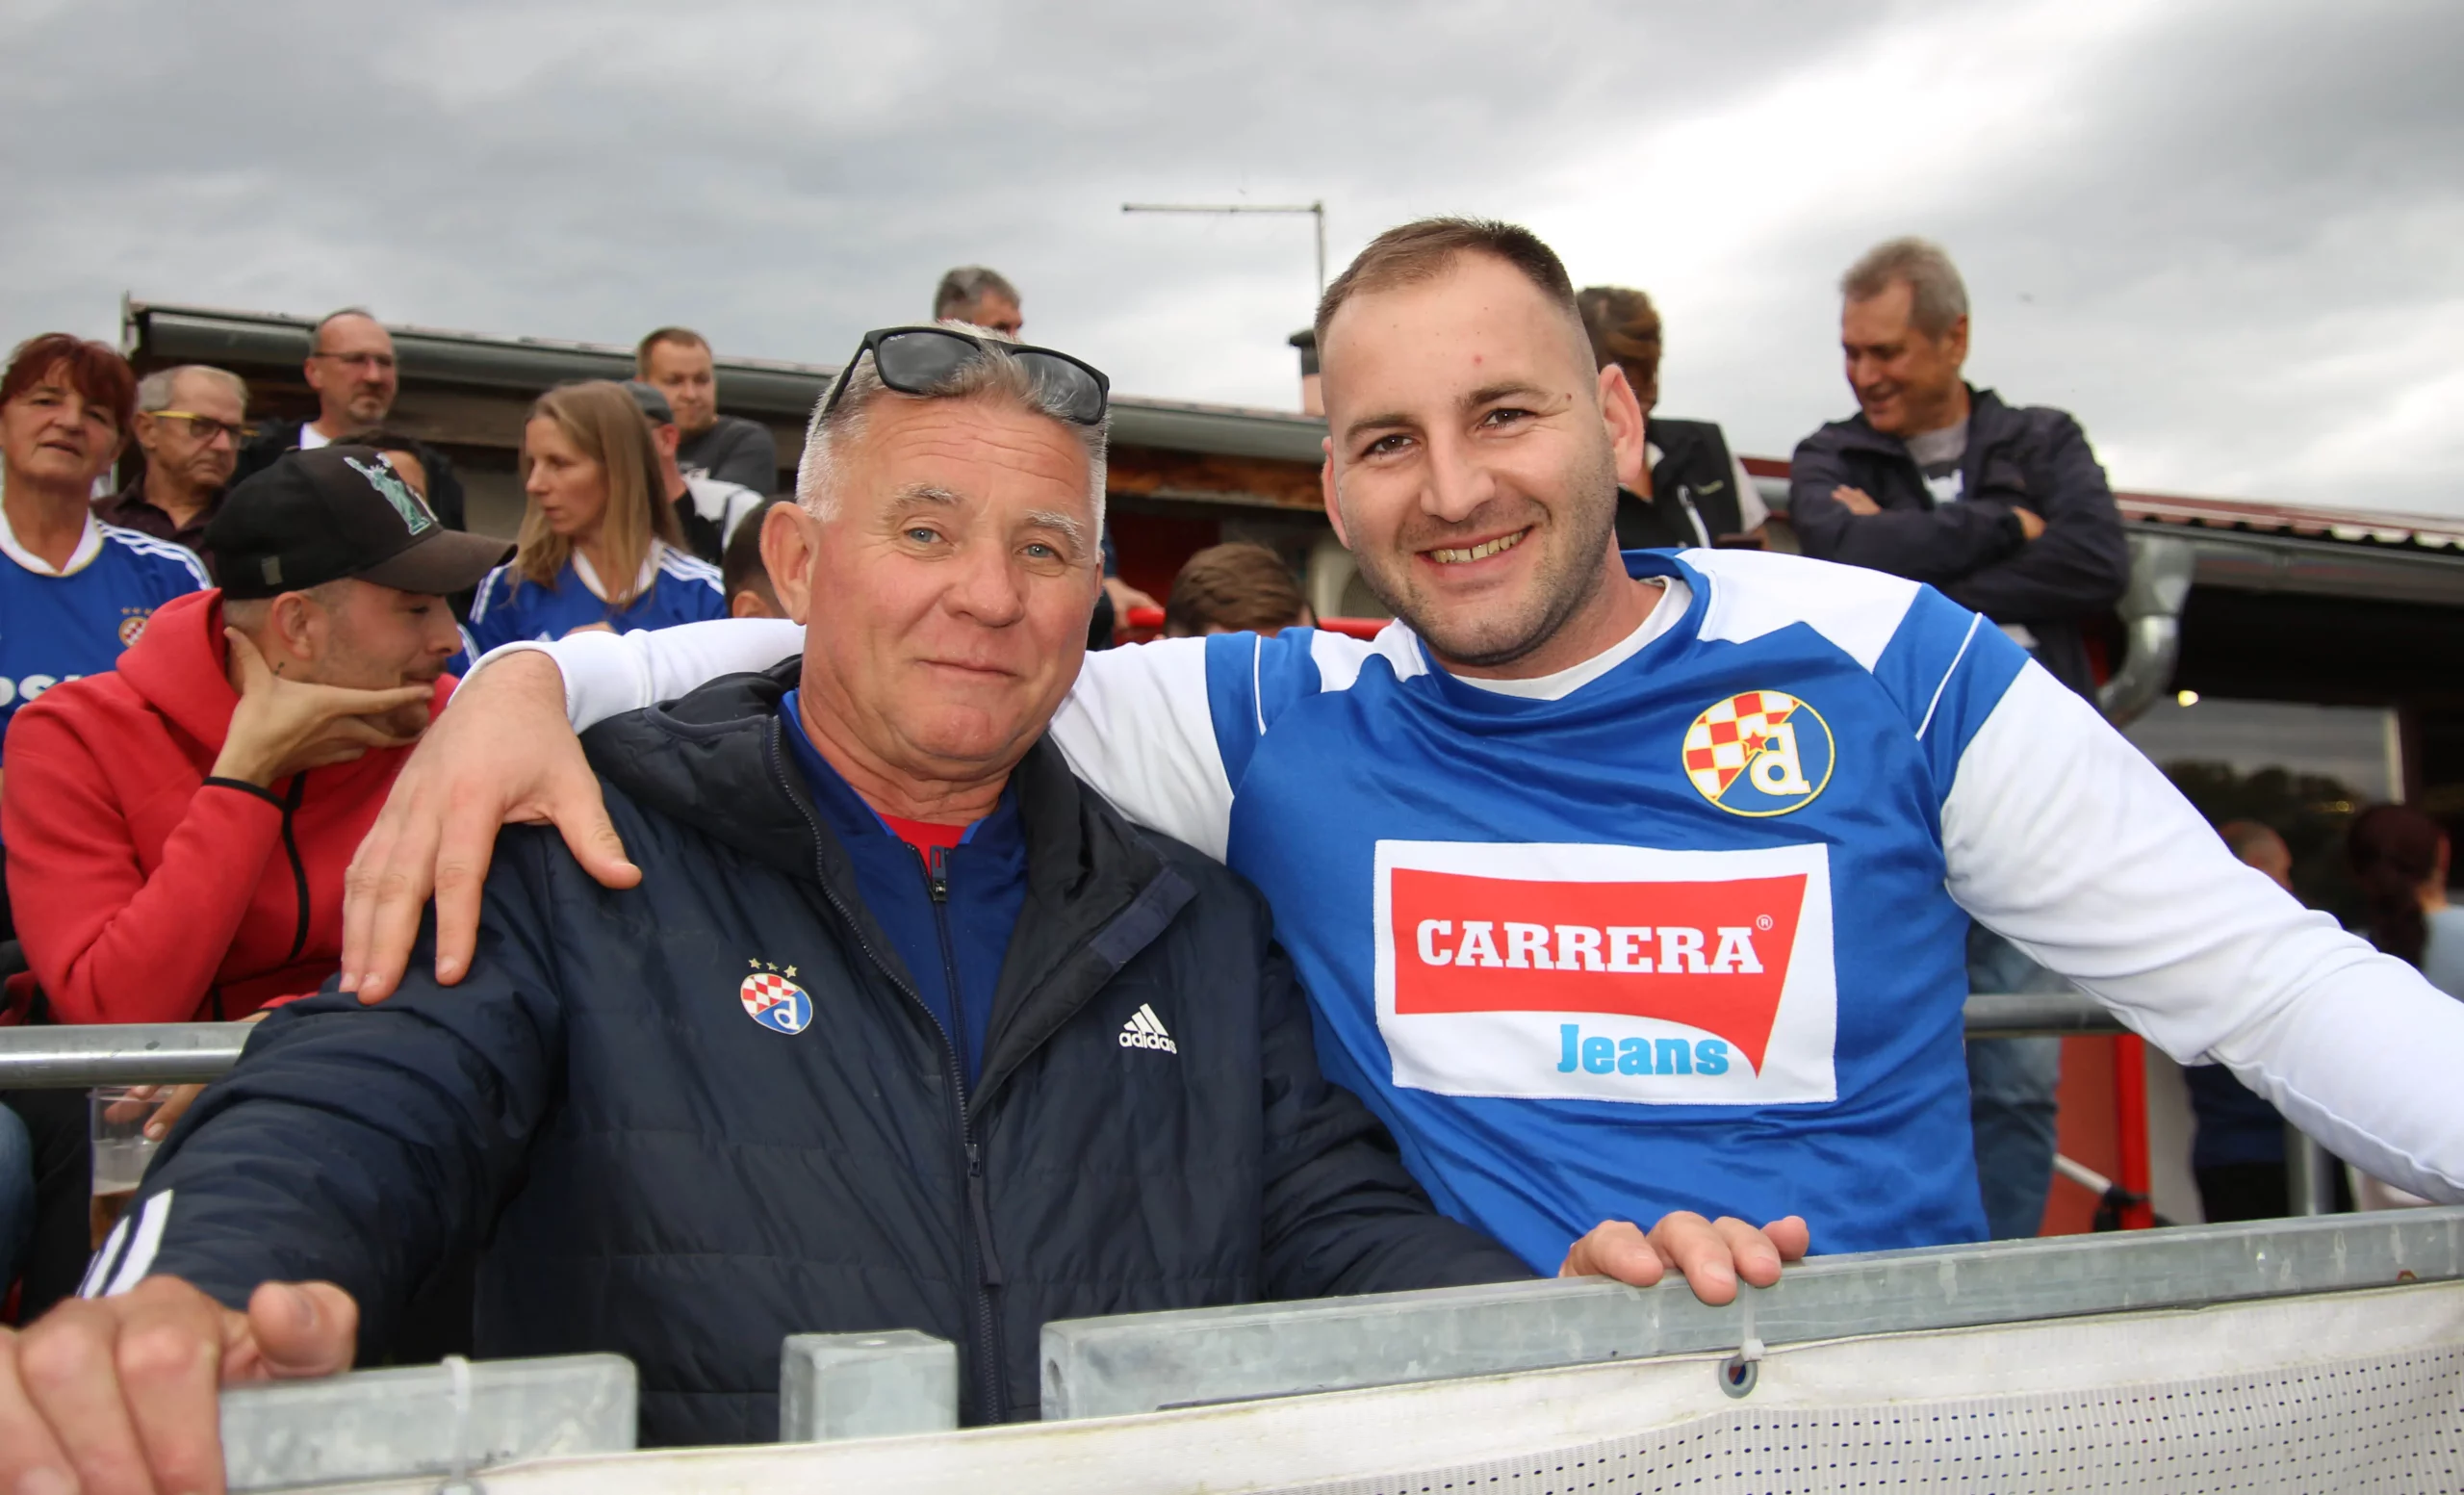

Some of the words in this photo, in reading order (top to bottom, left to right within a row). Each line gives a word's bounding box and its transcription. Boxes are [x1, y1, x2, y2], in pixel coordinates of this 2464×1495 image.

[1416, 919, 1763, 974] CARRERA
[1118, 1030, 1177, 1055] adidas
[1556, 1024, 1729, 1076] Jeans
